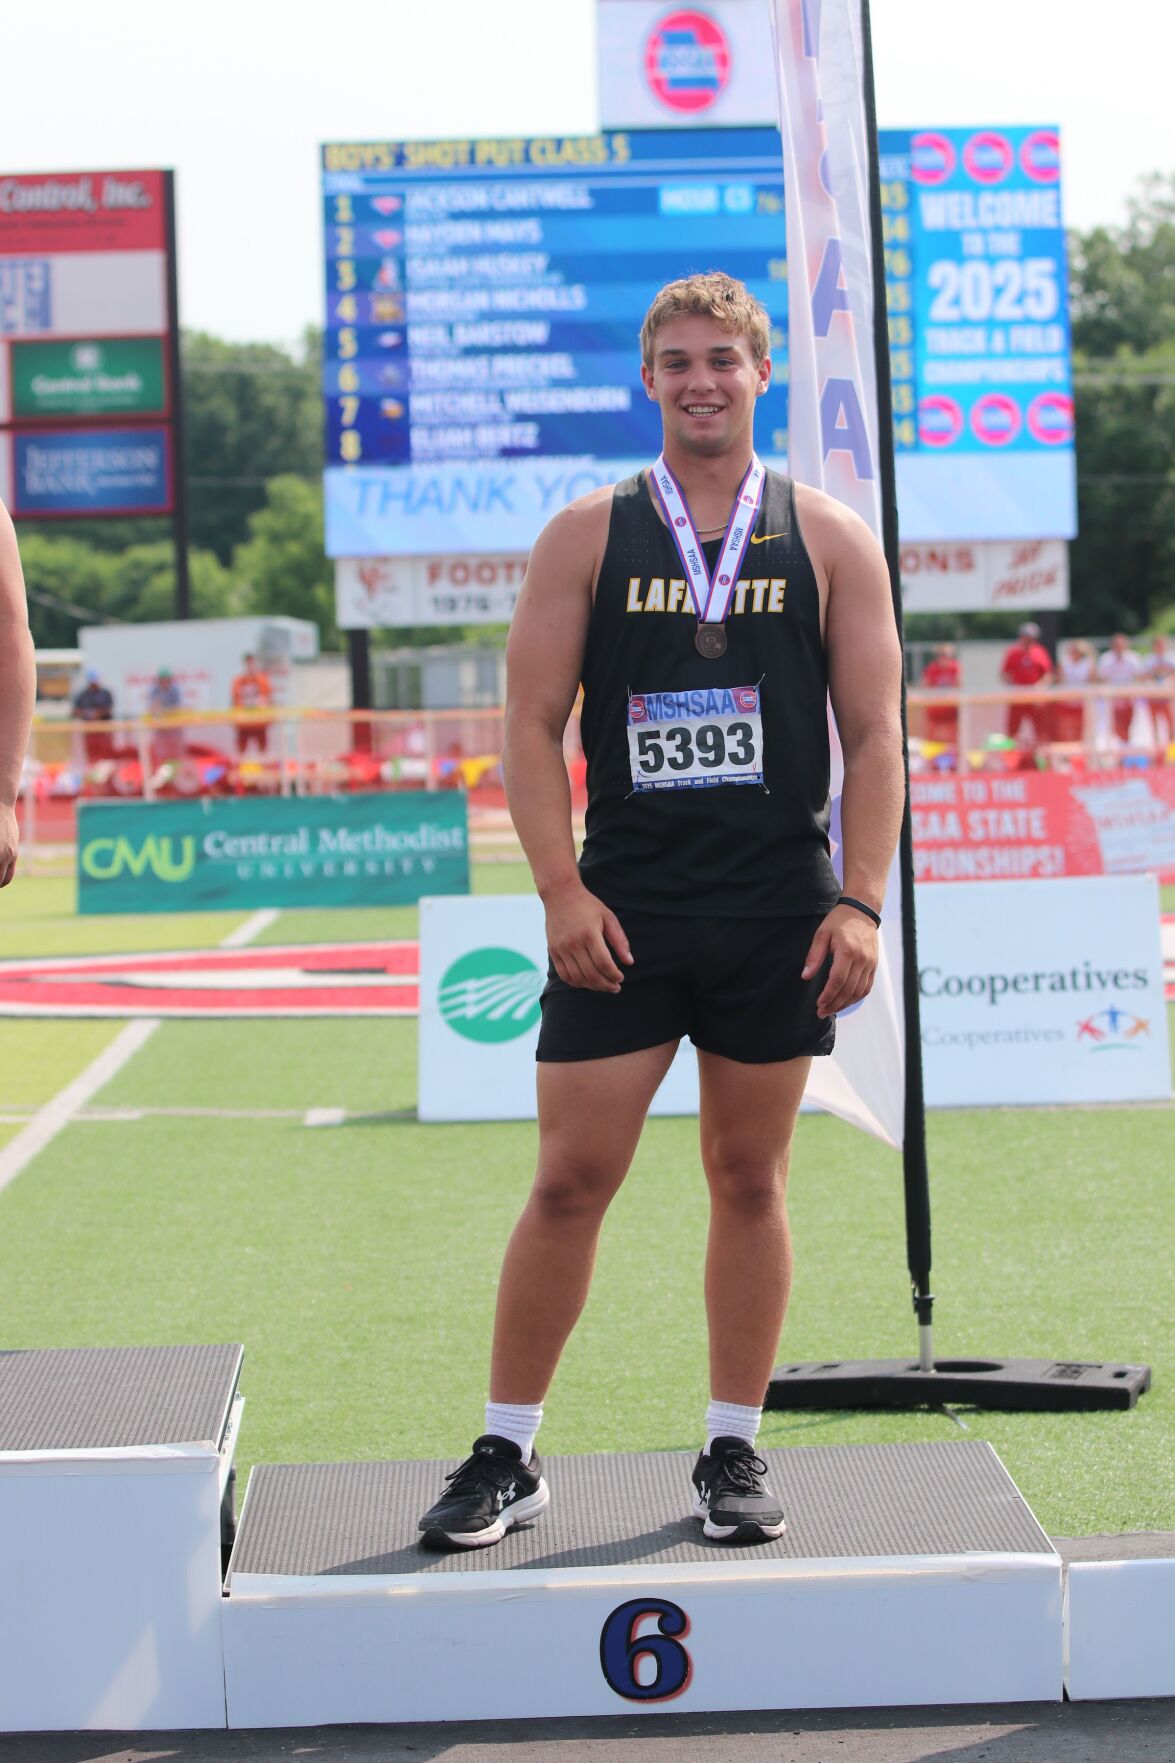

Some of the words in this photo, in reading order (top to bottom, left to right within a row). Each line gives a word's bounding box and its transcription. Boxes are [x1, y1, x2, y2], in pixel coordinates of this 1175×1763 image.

[405, 141, 470, 169] SHOT
[475, 139, 525, 167] PUT
[530, 135, 609, 166] CLASS
[0, 177, 97, 213] Control,
[102, 177, 152, 209] Inc.
[920, 190, 1059, 230] WELCOME
[335, 228, 354, 256] 2
[961, 234, 984, 256] TO
[989, 232, 1022, 255] THE
[336, 259, 357, 291] 3
[927, 258, 1058, 322] 2025
[336, 294, 358, 323] 4
[338, 326, 359, 359] 5
[924, 327, 987, 355] TRACK
[1010, 324, 1064, 353] FIELD
[338, 361, 359, 393] 6
[922, 358, 1065, 384] CHAMPIONSHIPS
[338, 394, 361, 427] 7
[340, 428, 361, 462] 8
[351, 477, 514, 516] THANK
[535, 474, 618, 512] YO
[729, 526, 744, 551] MSHSAA
[686, 548, 702, 576] MSHSAA
[626, 577, 787, 614] LAFTTE
[646, 688, 736, 721] MSHSAA
[637, 722, 755, 774] 5393
[655, 780, 675, 789] MSHSAA
[677, 778, 691, 787] Track
[706, 776, 719, 784] Field
[962, 779, 988, 803] TO
[991, 779, 1026, 802] THE
[967, 806, 1046, 840] STATE
[203, 830, 309, 858] Central
[318, 823, 463, 854] Methodist
[81, 833, 196, 883] CMU
[237, 859, 438, 881] UNIVERSITY
[918, 961, 1149, 1006] Cooperatives
[921, 1026, 1064, 1049] Cooperatives
[600, 1597, 694, 1704] 6
